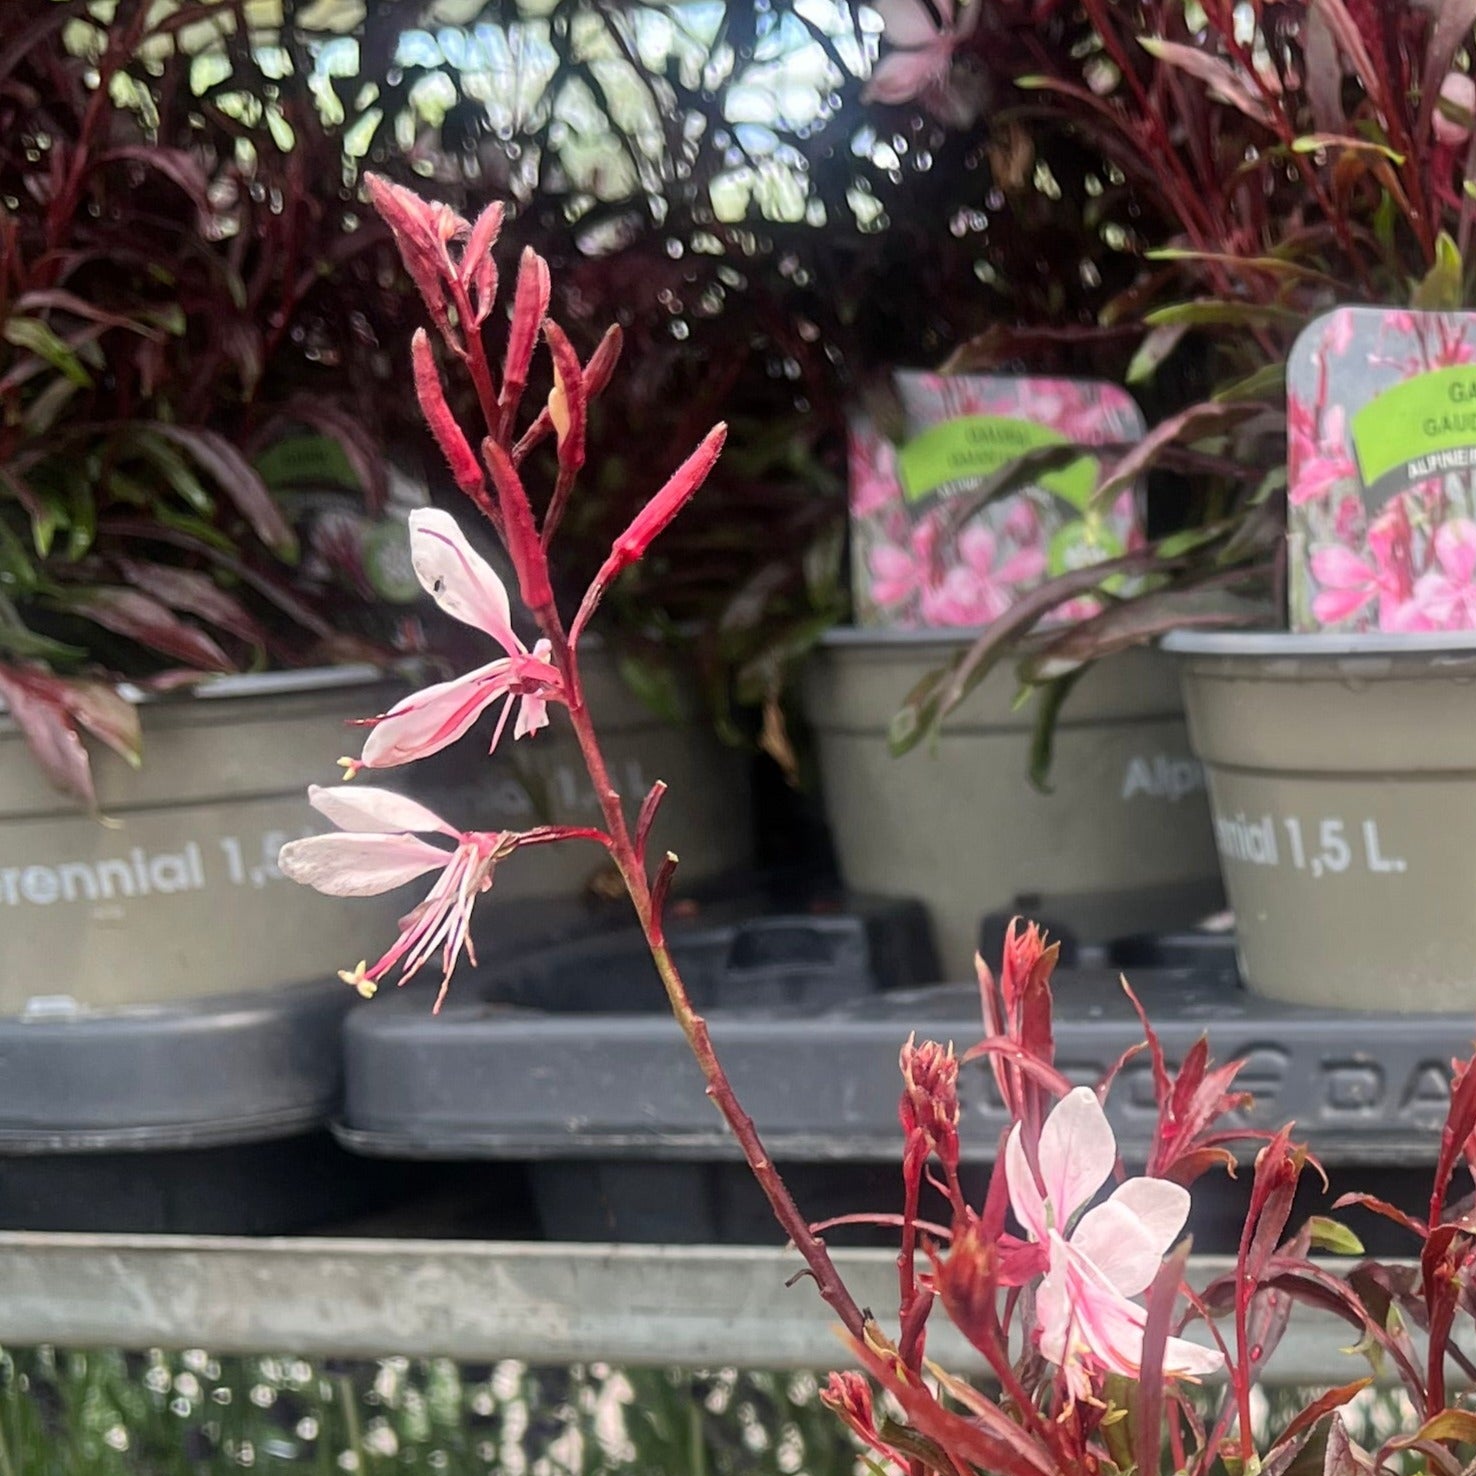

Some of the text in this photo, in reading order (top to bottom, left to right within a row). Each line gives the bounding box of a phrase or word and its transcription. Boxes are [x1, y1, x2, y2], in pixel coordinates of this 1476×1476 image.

[0, 841, 206, 906] rennial
[1283, 816, 1351, 879] 1,5
[1362, 819, 1408, 872] L.
